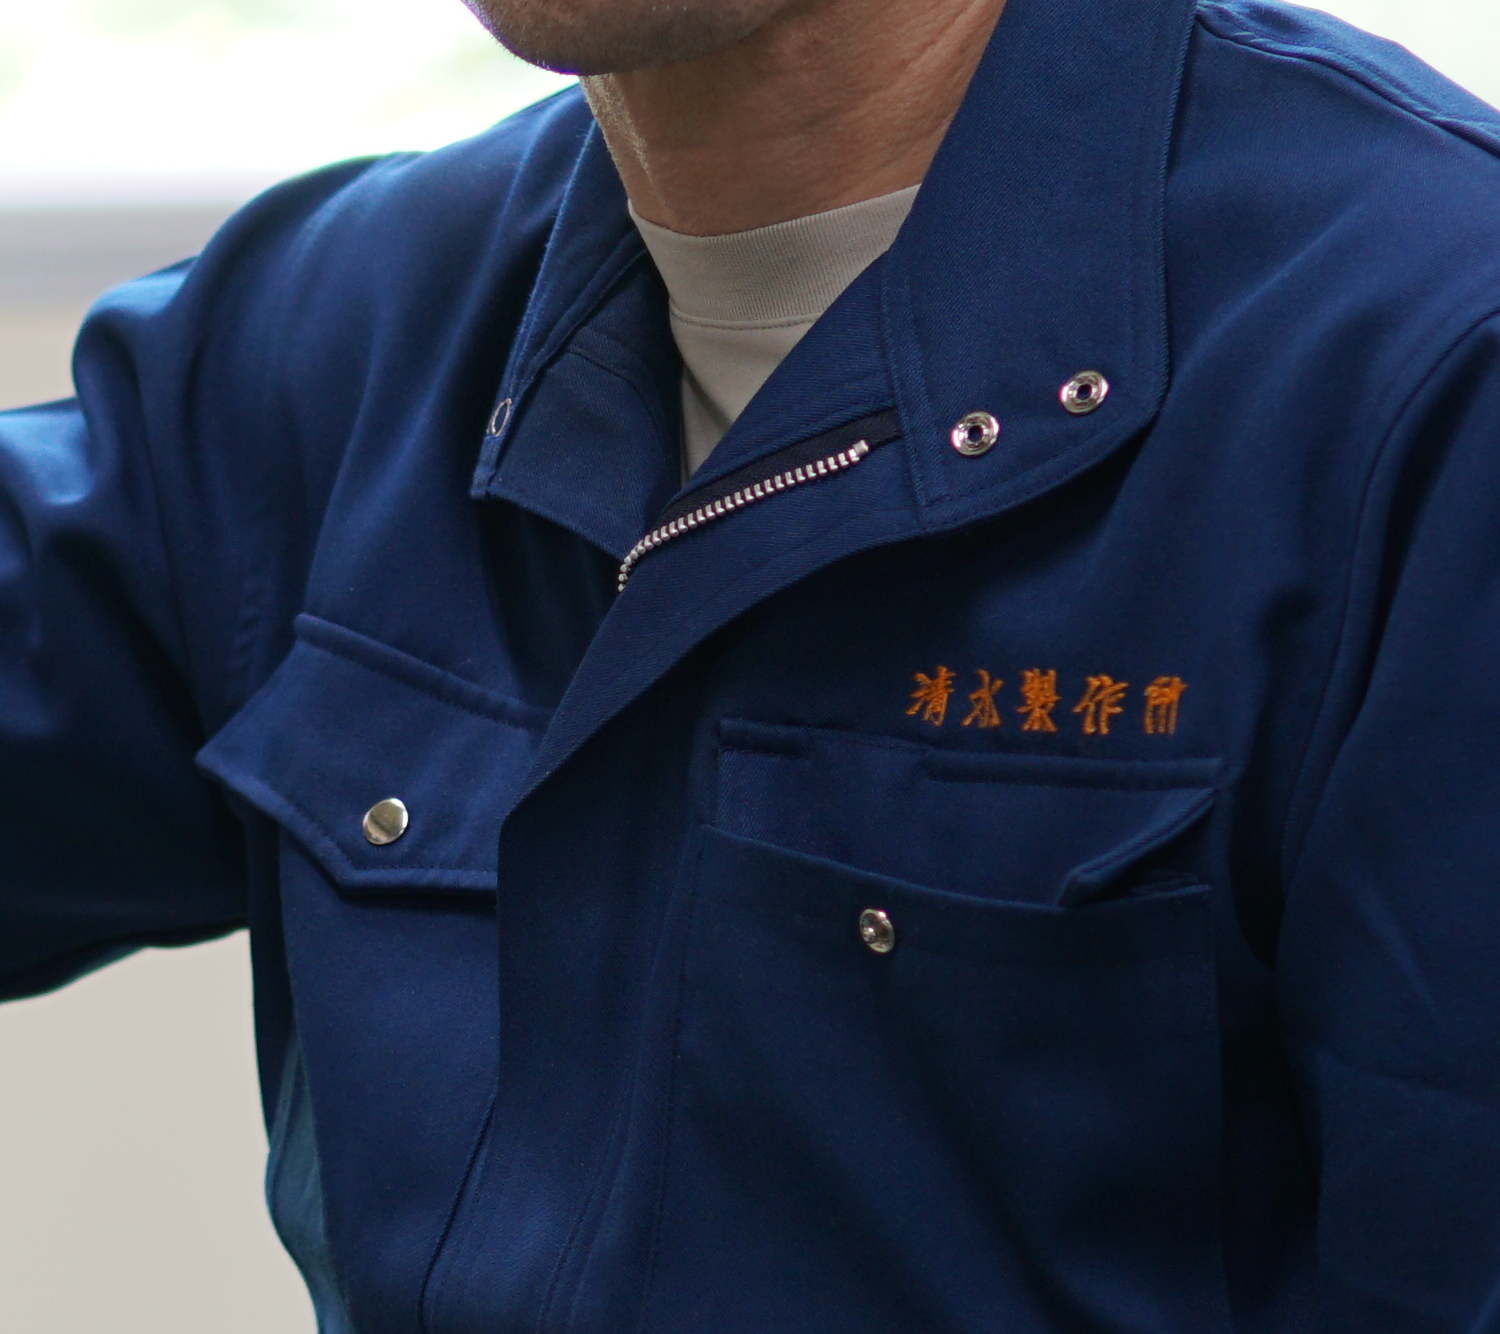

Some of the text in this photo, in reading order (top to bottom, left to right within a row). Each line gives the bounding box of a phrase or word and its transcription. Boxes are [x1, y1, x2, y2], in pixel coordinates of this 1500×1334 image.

[904, 665, 1189, 735] 清水製作所
